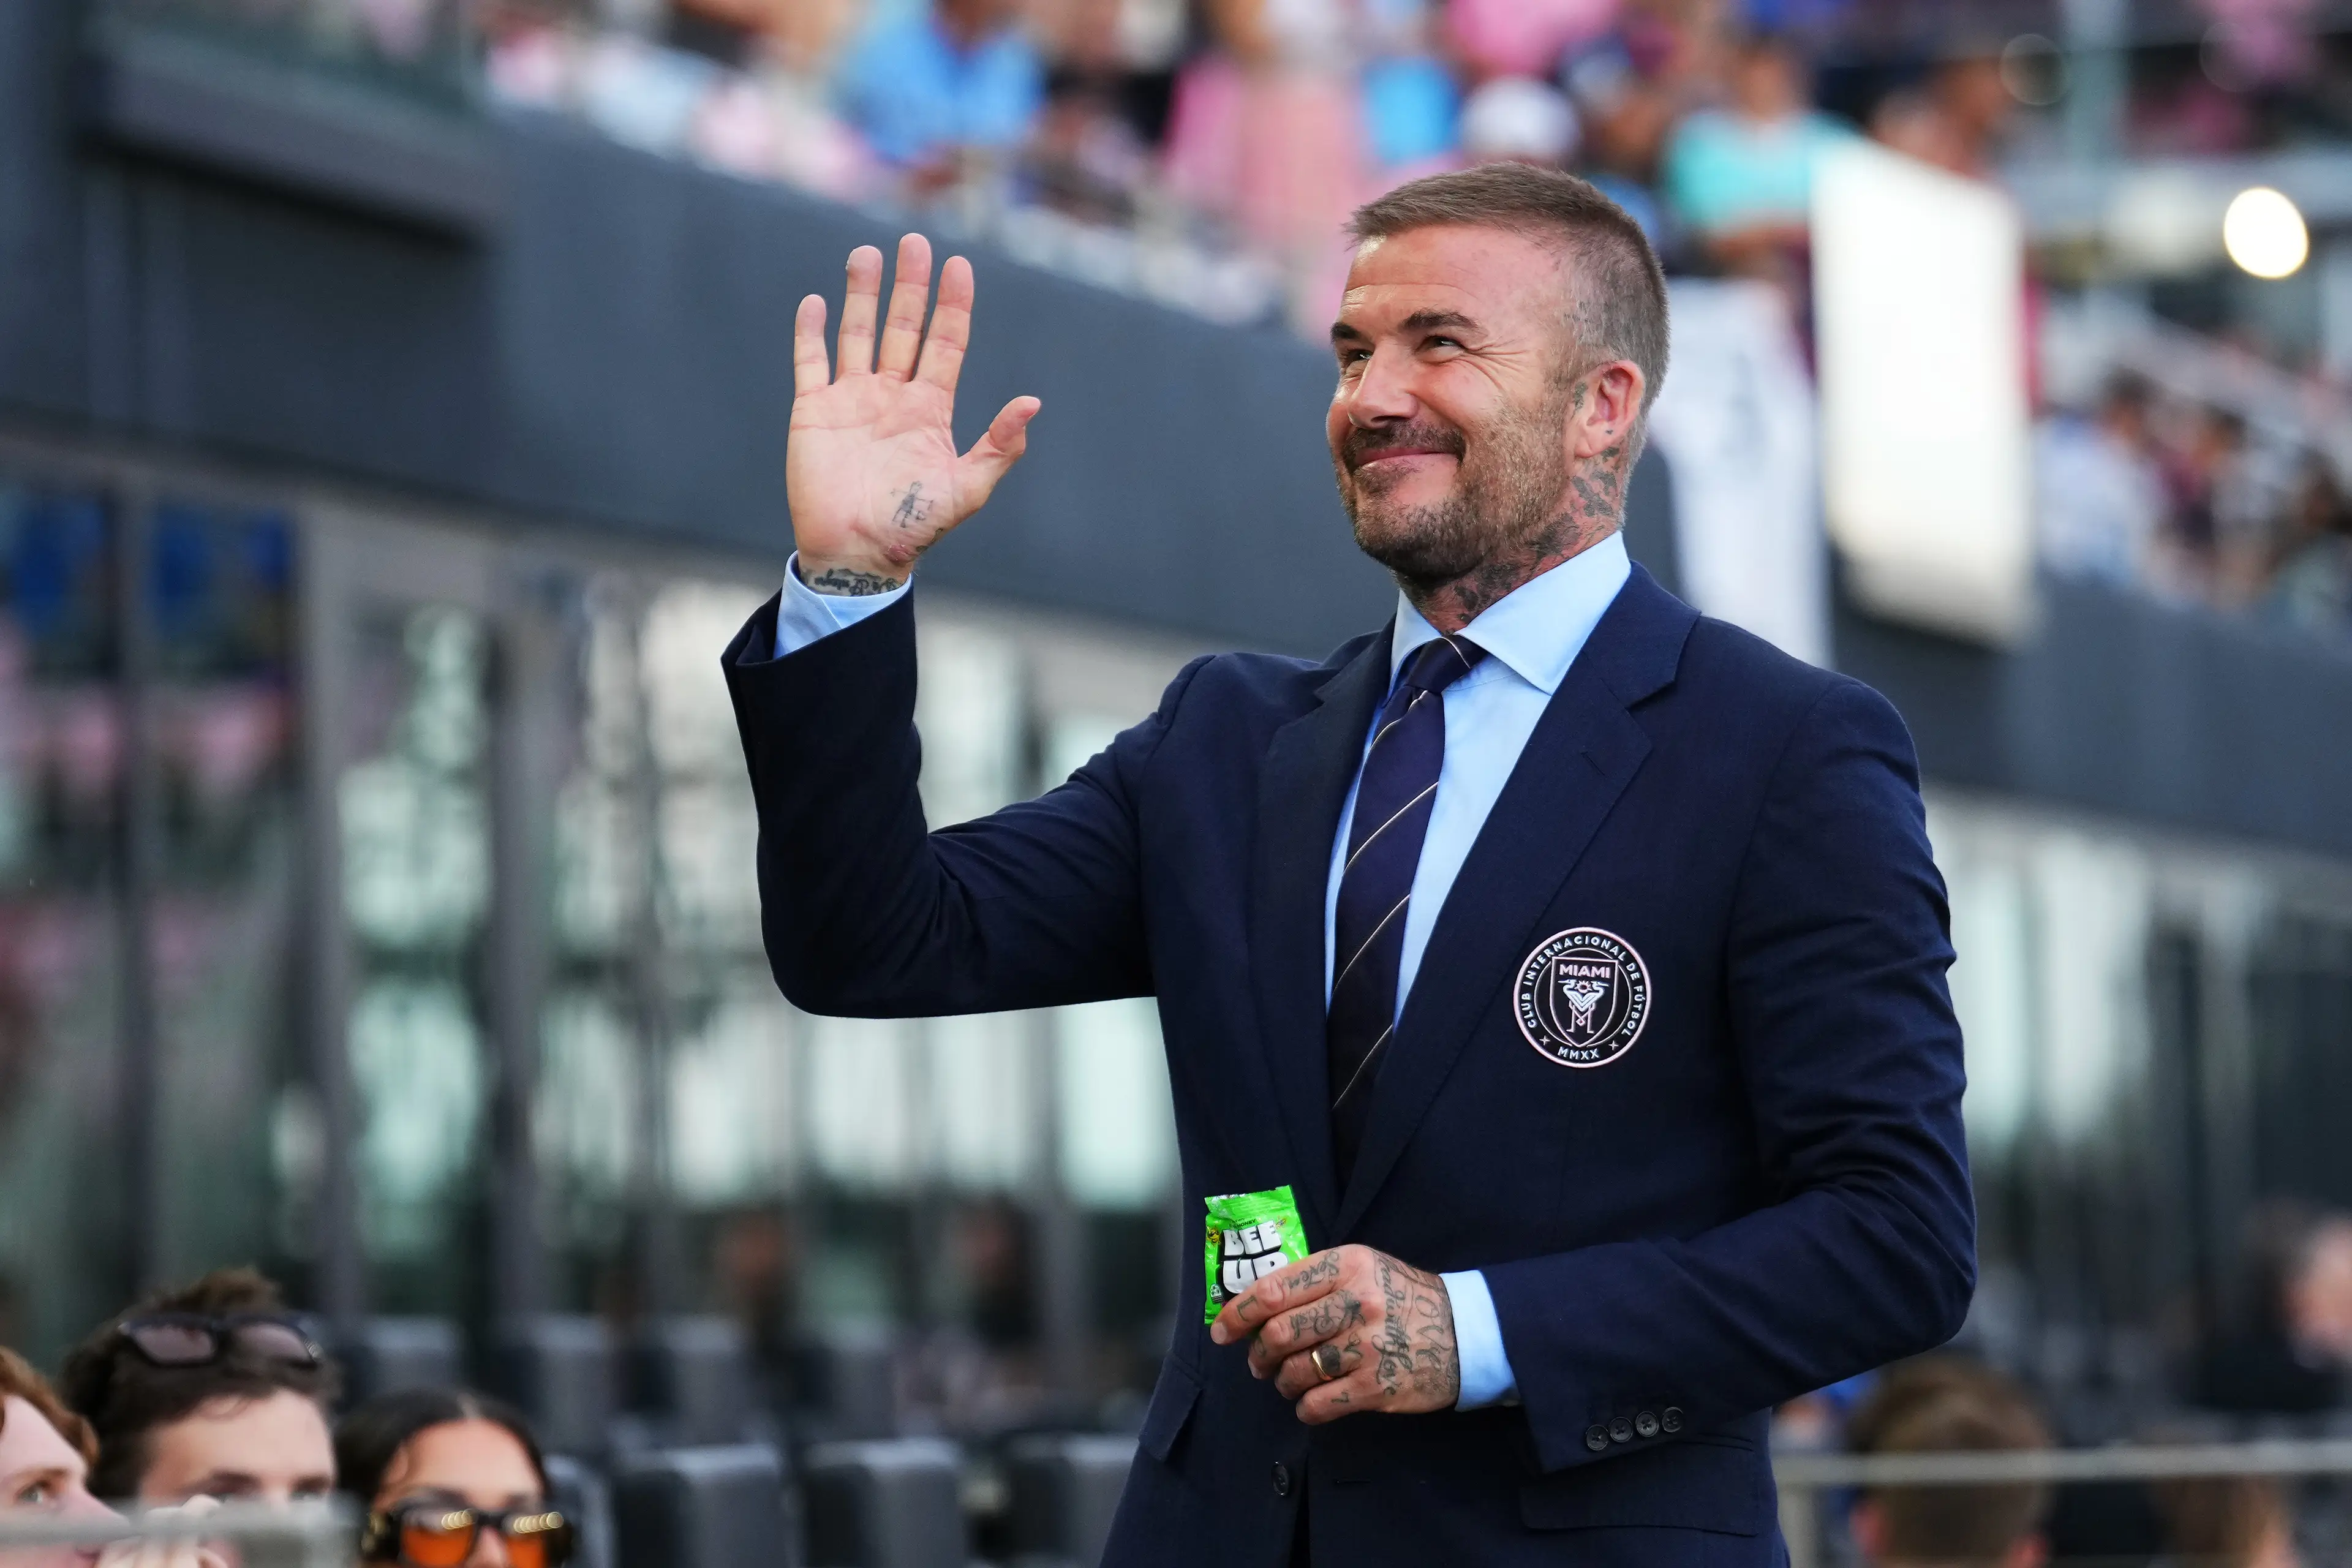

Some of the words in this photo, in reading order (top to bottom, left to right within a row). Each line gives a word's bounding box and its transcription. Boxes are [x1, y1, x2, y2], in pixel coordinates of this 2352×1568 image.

[1524, 935, 1626, 986] INTERNACIONAL
[1559, 964, 1610, 978] MIAMI
[1626, 963, 1640, 981] DE
[1521, 994, 1537, 1028] CLUB
[1621, 986, 1646, 1036] FÚTBOL
[1558, 1046, 1600, 1060] MMXX
[1223, 1220, 1282, 1256] BEE
